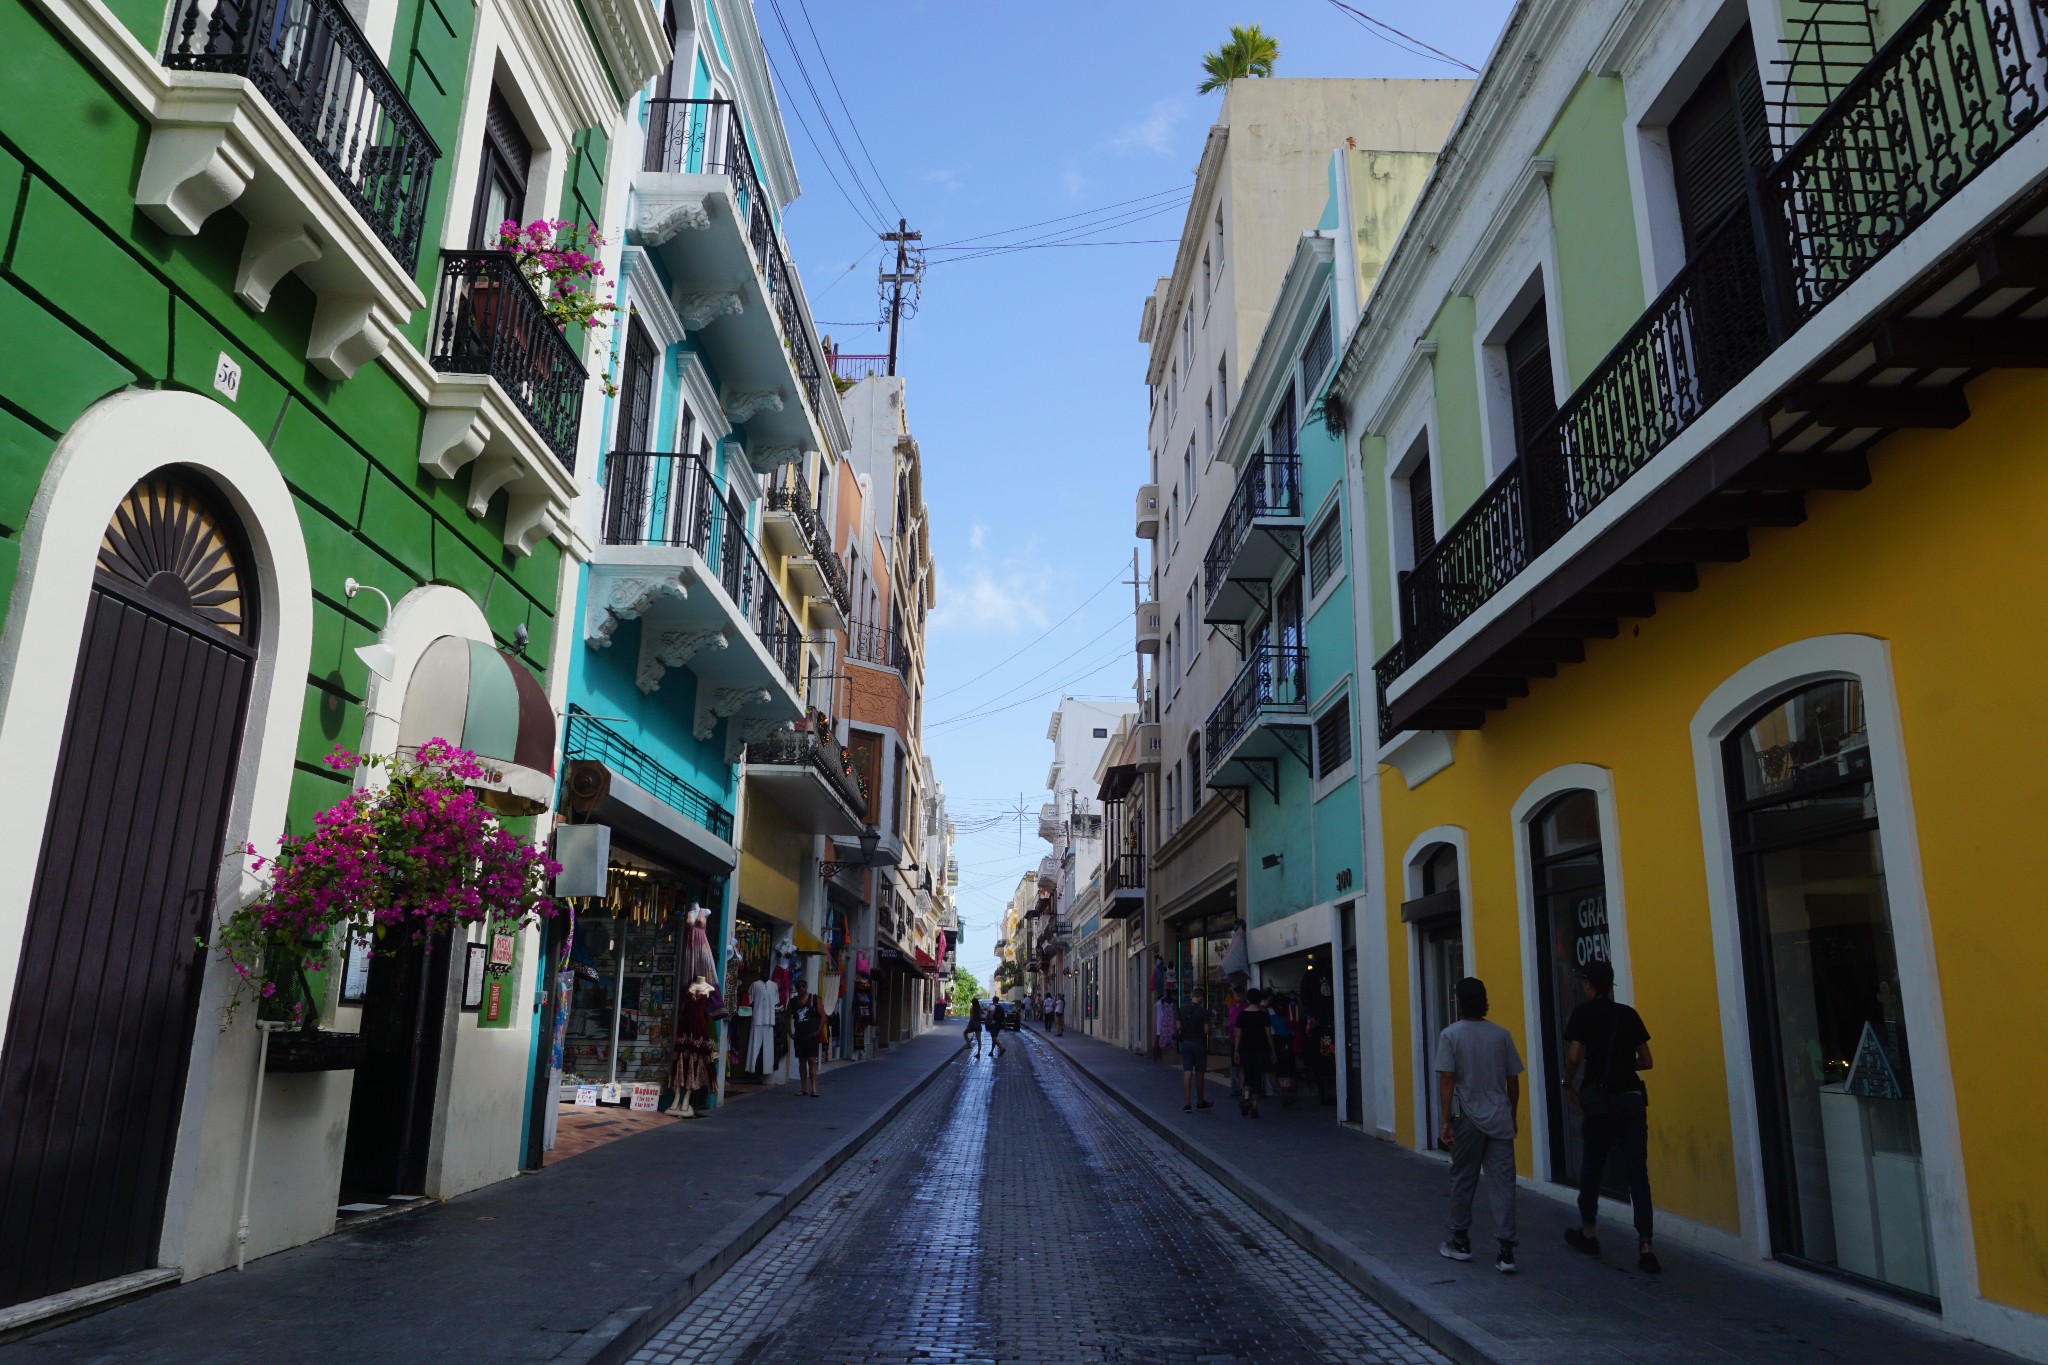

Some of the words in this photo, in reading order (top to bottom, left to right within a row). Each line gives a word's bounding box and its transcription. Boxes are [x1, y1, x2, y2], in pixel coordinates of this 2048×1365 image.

[218, 363, 237, 391] 56
[1336, 867, 1353, 892] 300
[1578, 896, 1609, 929] GRA
